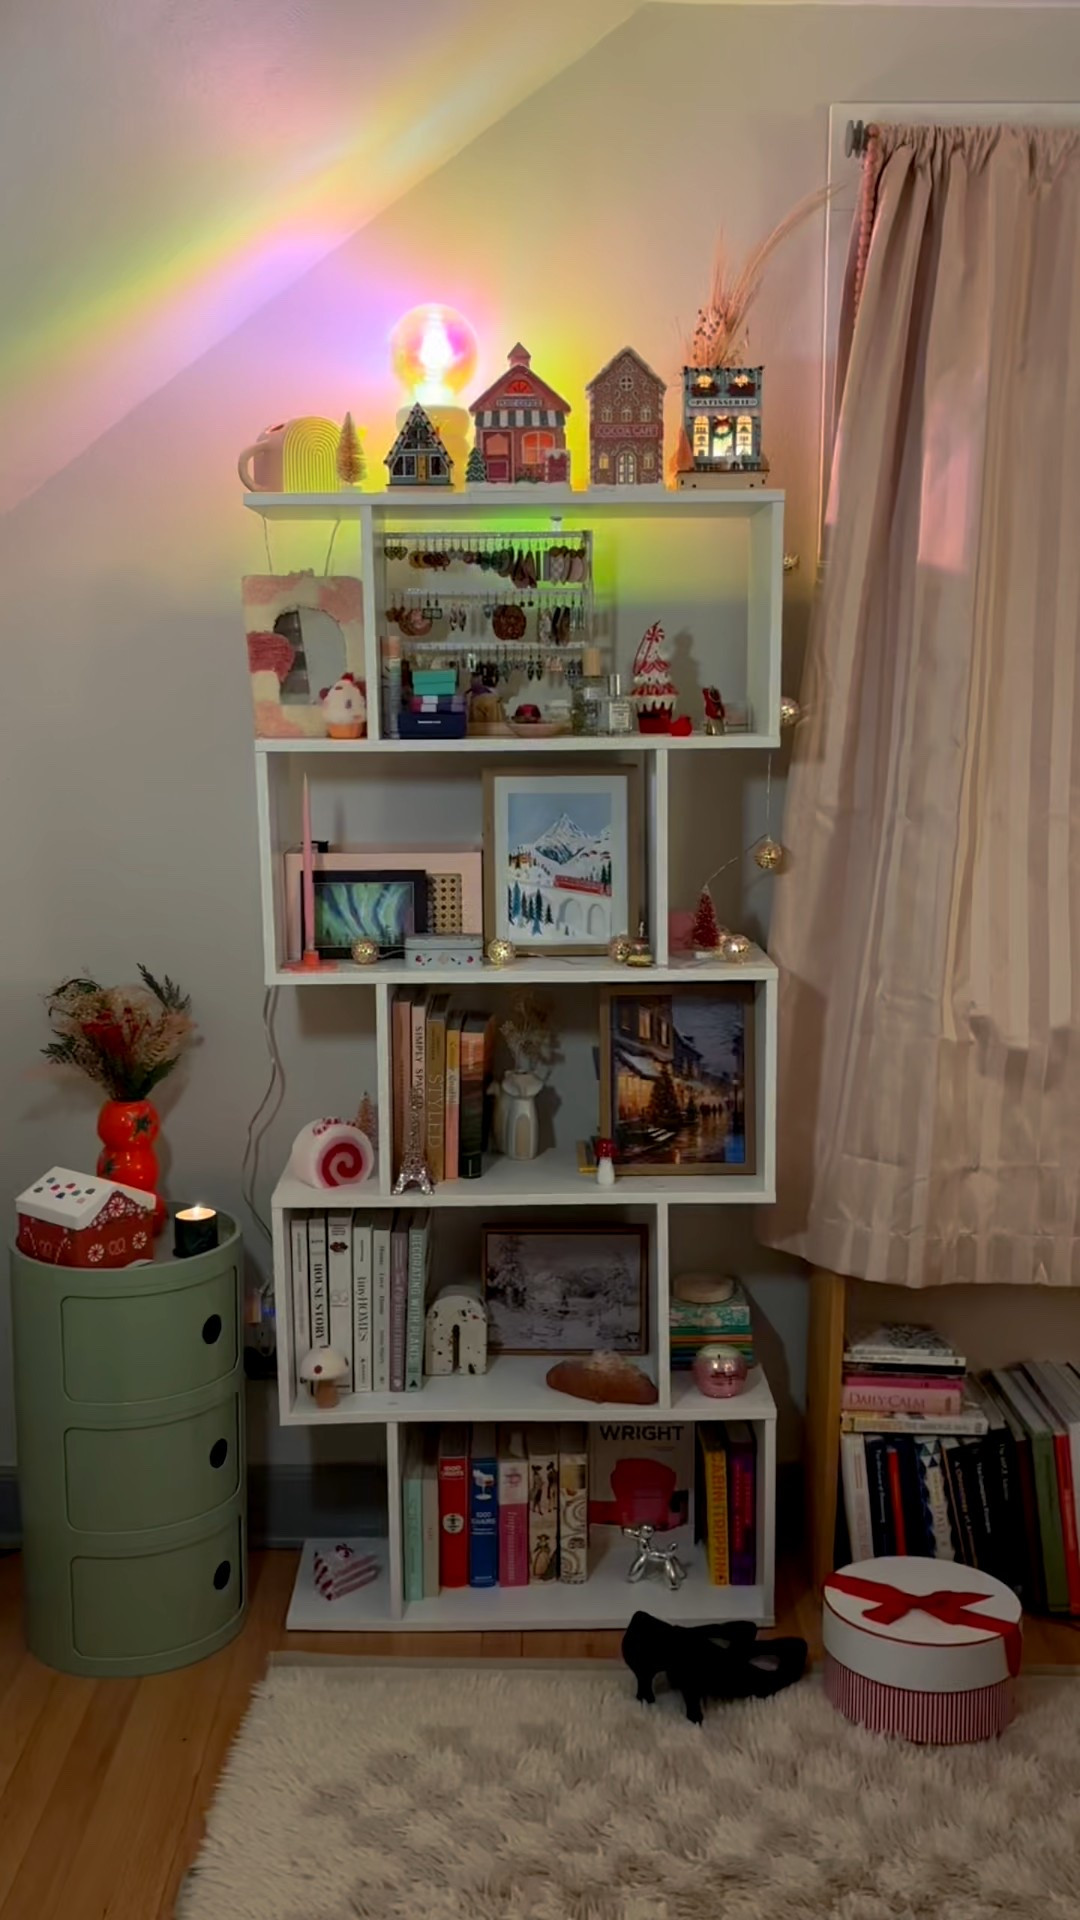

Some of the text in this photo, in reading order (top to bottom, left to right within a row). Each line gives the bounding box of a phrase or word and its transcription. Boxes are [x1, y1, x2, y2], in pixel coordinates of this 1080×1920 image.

[415, 1026, 424, 1063] SIMPLY
[428, 1074, 444, 1148] STYLED
[410, 1234, 422, 1295] DECORATING
[314, 1263, 325, 1339] HOUSE STORY
[409, 1298, 421, 1322] WITH
[849, 1392, 884, 1406] DAILY
[599, 1425, 685, 1441] WRIGHT
